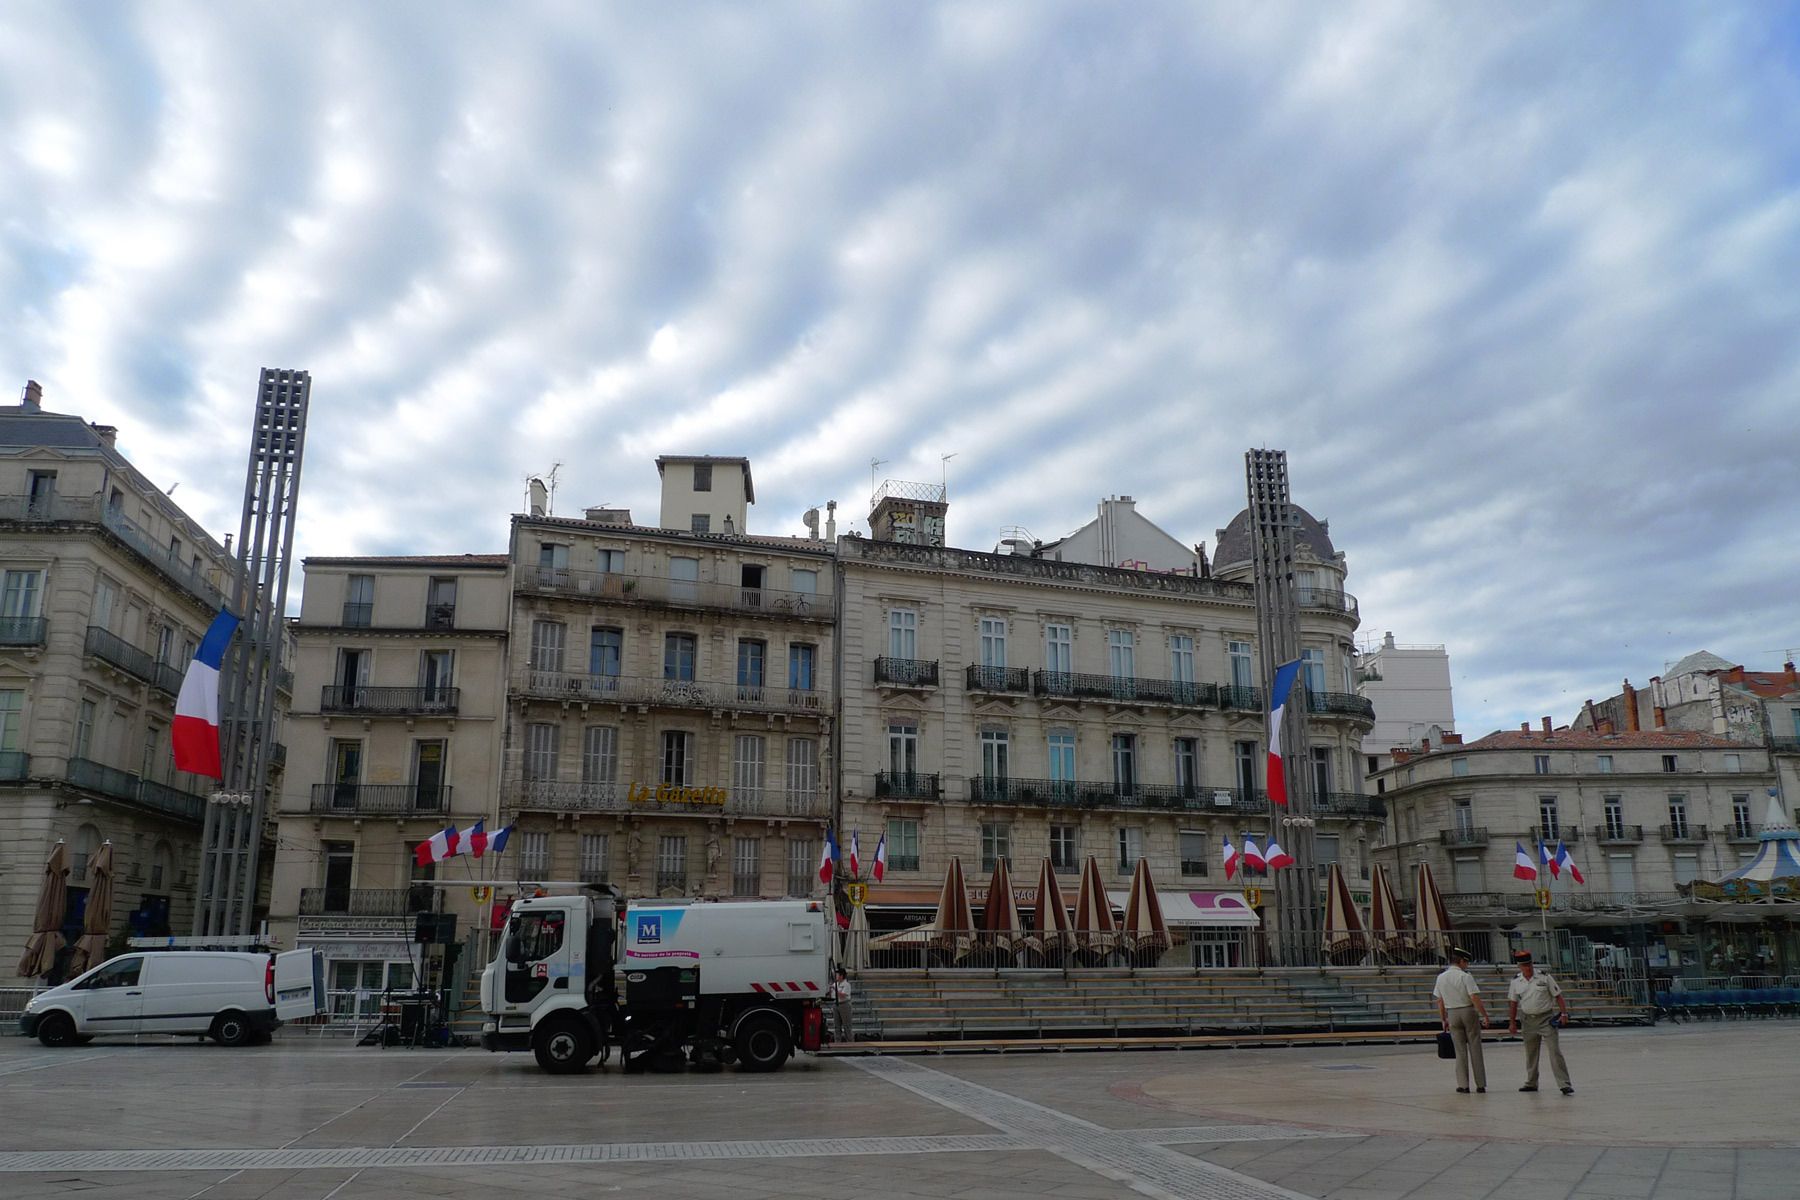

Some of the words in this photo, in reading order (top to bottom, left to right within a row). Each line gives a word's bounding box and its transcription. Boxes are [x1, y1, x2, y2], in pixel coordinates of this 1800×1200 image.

[628, 781, 650, 803] La
[656, 783, 727, 806] Gazette
[642, 924, 657, 937] M
